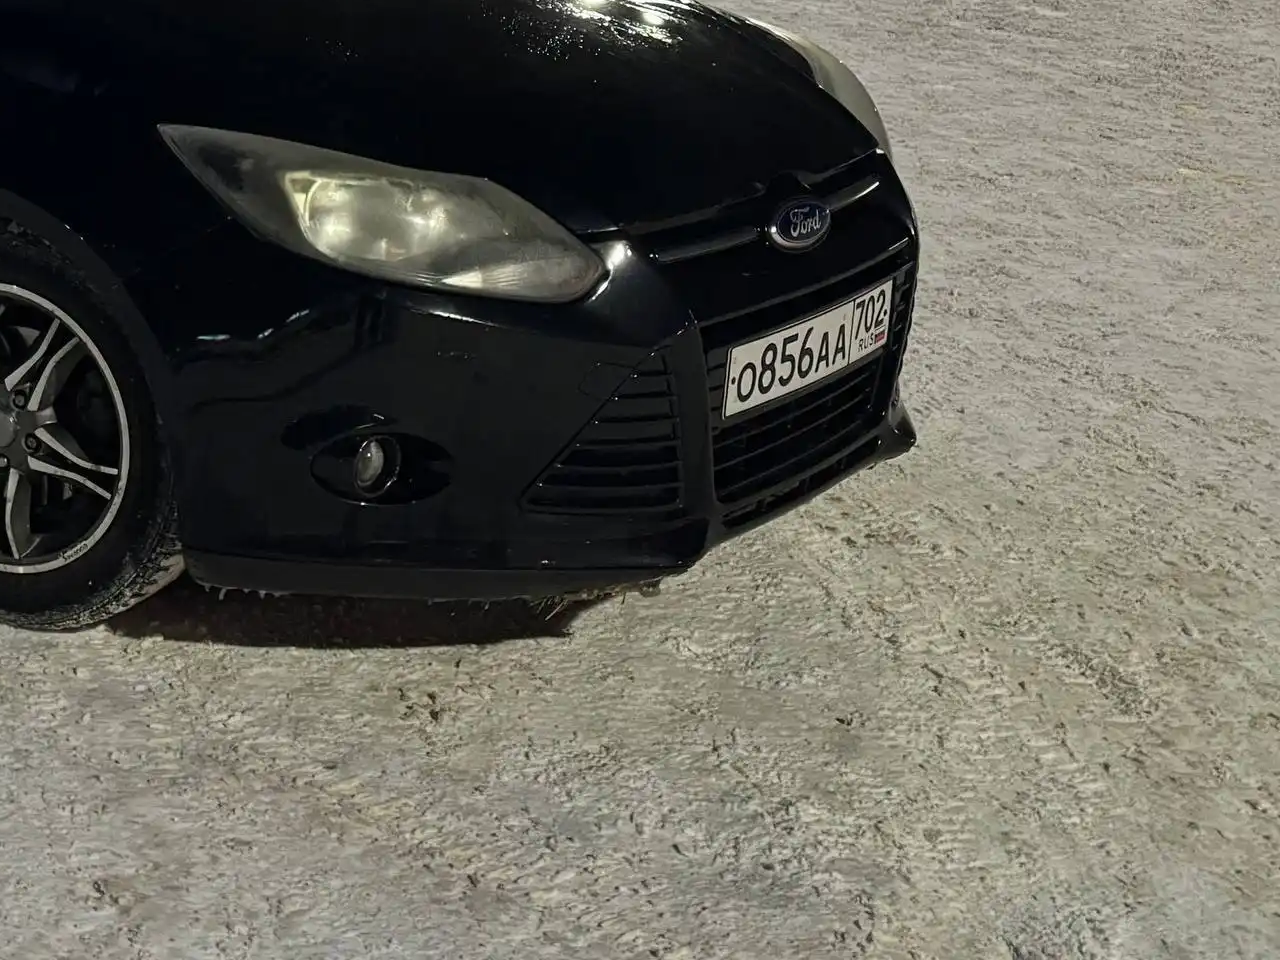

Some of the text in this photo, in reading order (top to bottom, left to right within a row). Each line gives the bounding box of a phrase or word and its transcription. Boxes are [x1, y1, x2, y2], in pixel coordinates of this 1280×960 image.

[789, 207, 821, 237] Ford
[737, 289, 886, 403] О856АА 702
[857, 332, 874, 353] RUS
